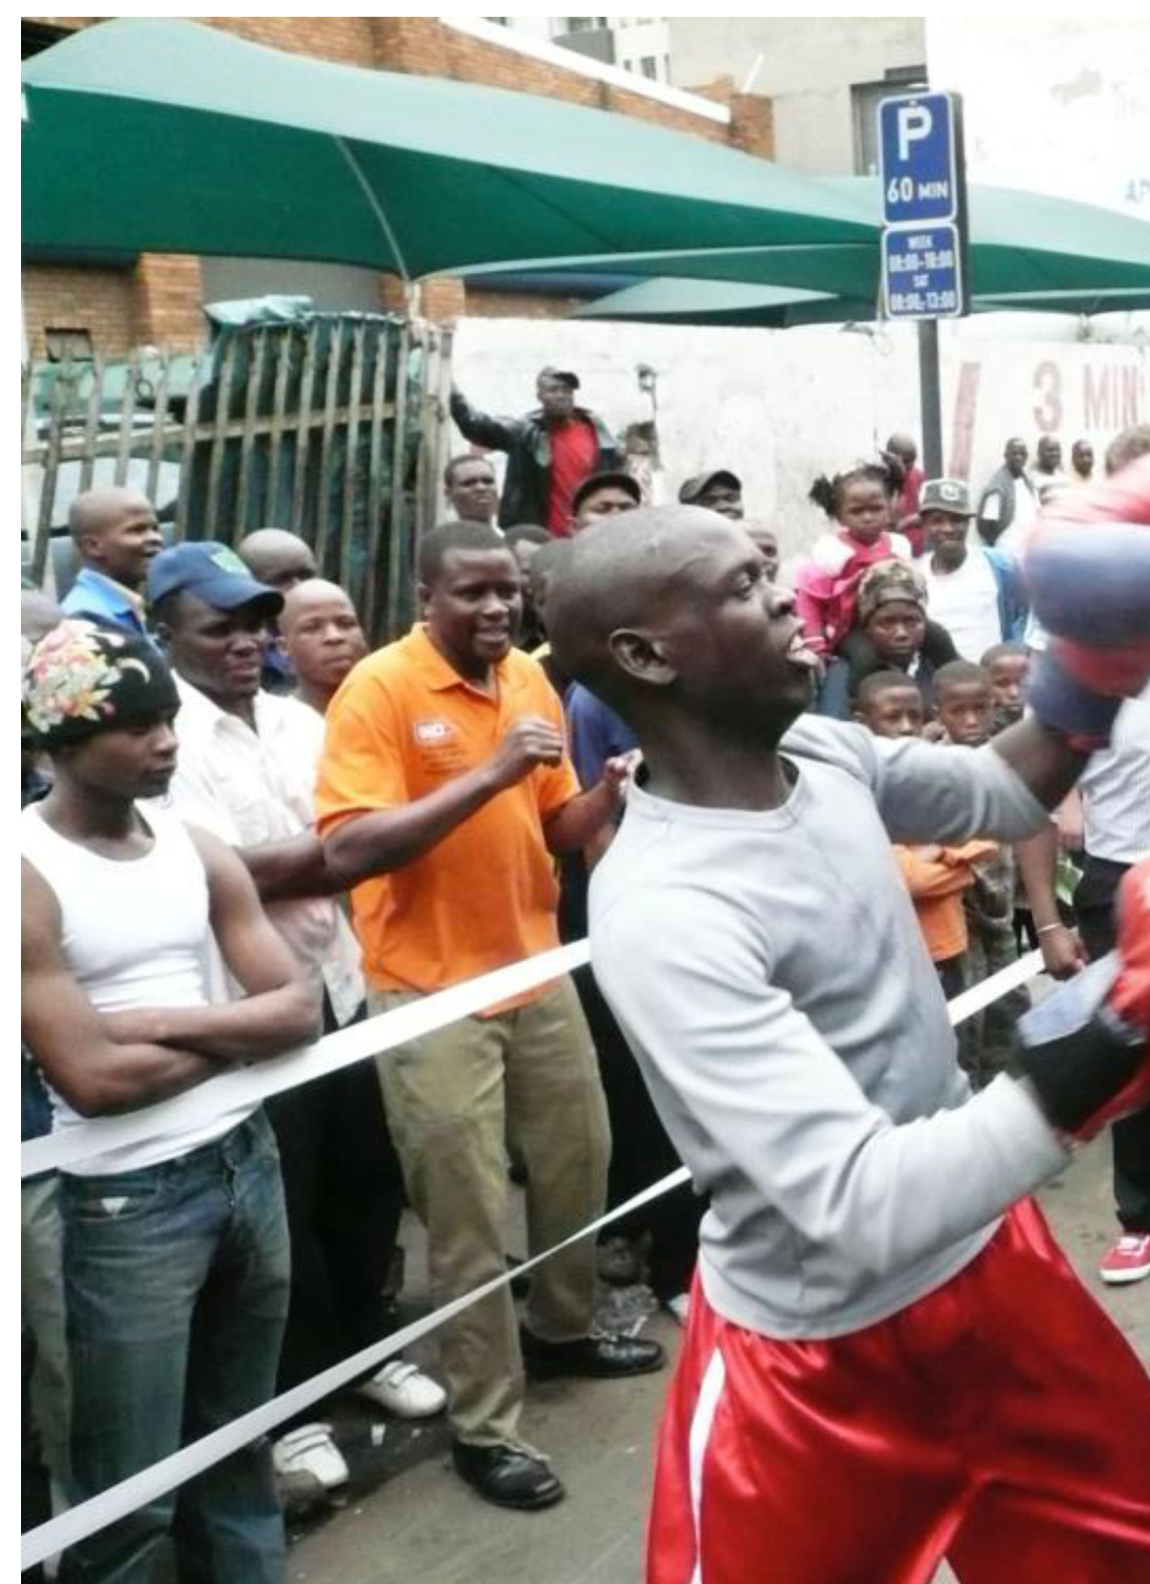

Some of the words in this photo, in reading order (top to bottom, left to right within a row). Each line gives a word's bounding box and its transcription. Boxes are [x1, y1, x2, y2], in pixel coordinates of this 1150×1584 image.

[897, 107, 933, 161] P
[887, 177, 914, 203] 60
[918, 181, 948, 200] MIN
[1032, 359, 1063, 432] 3
